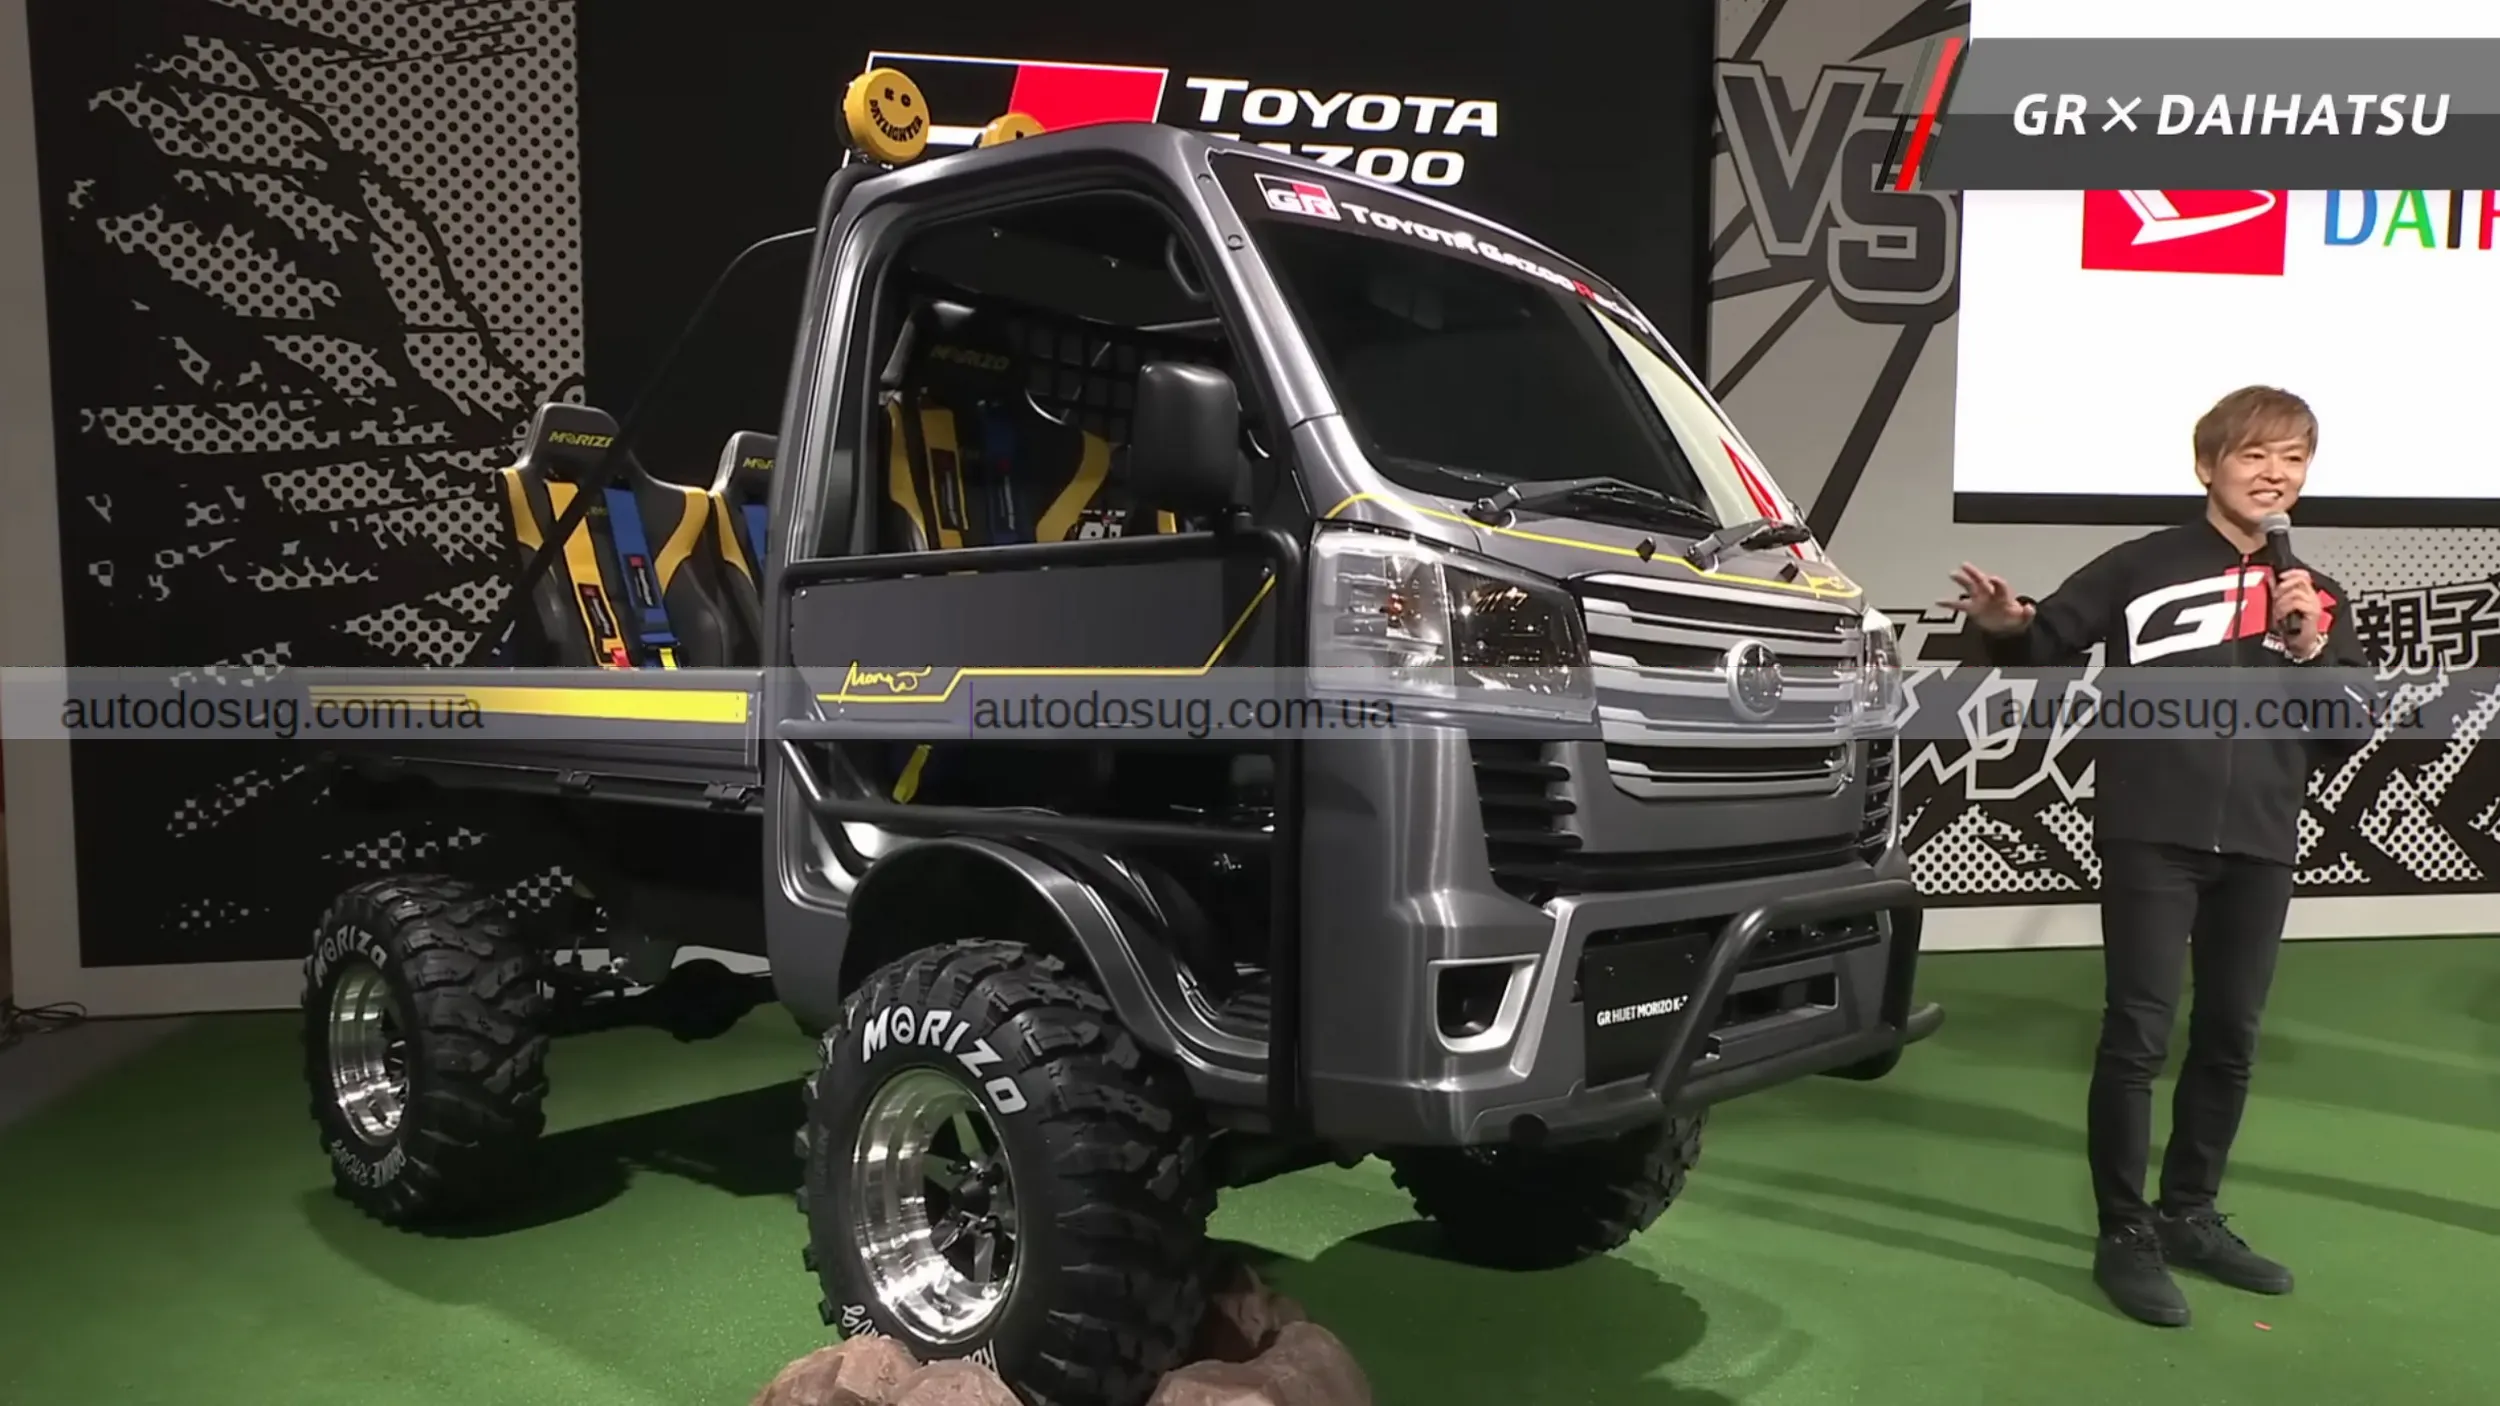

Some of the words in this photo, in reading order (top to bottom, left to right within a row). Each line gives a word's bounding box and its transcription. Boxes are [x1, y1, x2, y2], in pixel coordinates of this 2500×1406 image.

[869, 99, 923, 142] DAYLIGHTER
[1186, 77, 1498, 137] TOYOTA
[1208, 132, 1465, 187] ZOO
[1714, 60, 1960, 310] VS
[1264, 186, 1337, 217] GR
[1341, 202, 1478, 256] TOYOTA
[314, 924, 387, 988] MORIZO
[1597, 1010, 1612, 1026] GR
[1637, 998, 1673, 1018] MORIZO
[862, 1005, 1028, 1115] MORIZO
